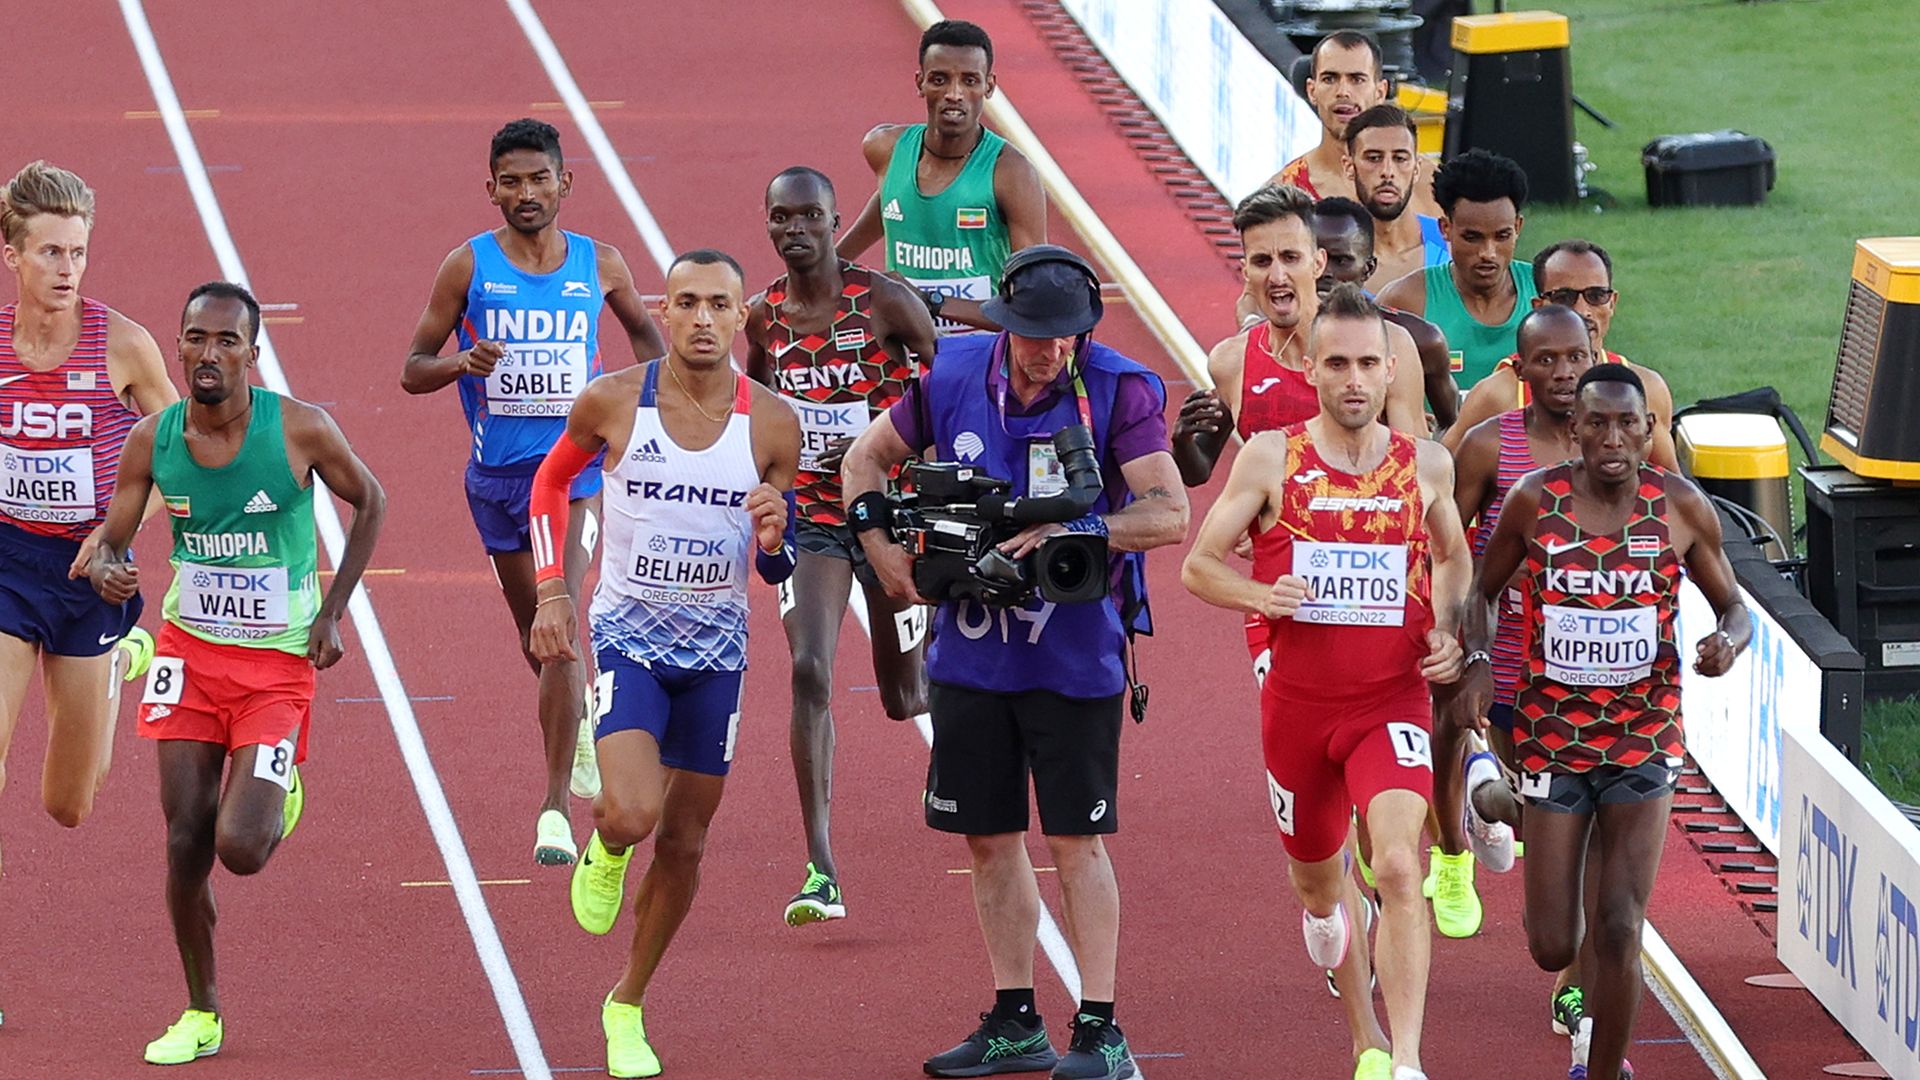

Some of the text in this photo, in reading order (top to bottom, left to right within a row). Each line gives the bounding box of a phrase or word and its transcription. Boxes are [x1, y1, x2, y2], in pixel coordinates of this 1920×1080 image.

[896, 241, 973, 270] ETHIOPIA
[486, 309, 588, 342] INDIA
[514, 349, 572, 367] TDK
[500, 373, 572, 395] SABLE
[776, 363, 867, 391] KENYA
[502, 404, 571, 415] OREGON22
[799, 406, 852, 426] TDK
[16, 455, 76, 474] TDK
[631, 453, 667, 463] adidas
[5, 476, 77, 502] JAGER
[627, 479, 748, 508] FRANCE
[7, 506, 78, 521] OREGON22
[243, 503, 278, 514] adidas
[1308, 496, 1404, 512] ESPAÑA
[182, 531, 269, 559] ETHIOPIA
[668, 536, 726, 557] TDK
[634, 555, 731, 584] BELHADJ
[1329, 550, 1391, 570] TDK
[210, 572, 271, 592] TDK
[1301, 575, 1399, 602] MARTOS
[1545, 567, 1656, 595] KENYA
[199, 593, 267, 620] WALE
[641, 589, 716, 604] OREGON22
[1310, 609, 1387, 624] OREGON22
[1578, 615, 1640, 635] TDK
[196, 624, 270, 640] OREGON22
[1550, 636, 1649, 664] KIPRUTO
[154, 665, 172, 695] 8
[1559, 671, 1636, 685] OREGON22
[271, 747, 288, 777] 8
[1812, 803, 1858, 992] TDK
[1890, 882, 1920, 1062] TD
